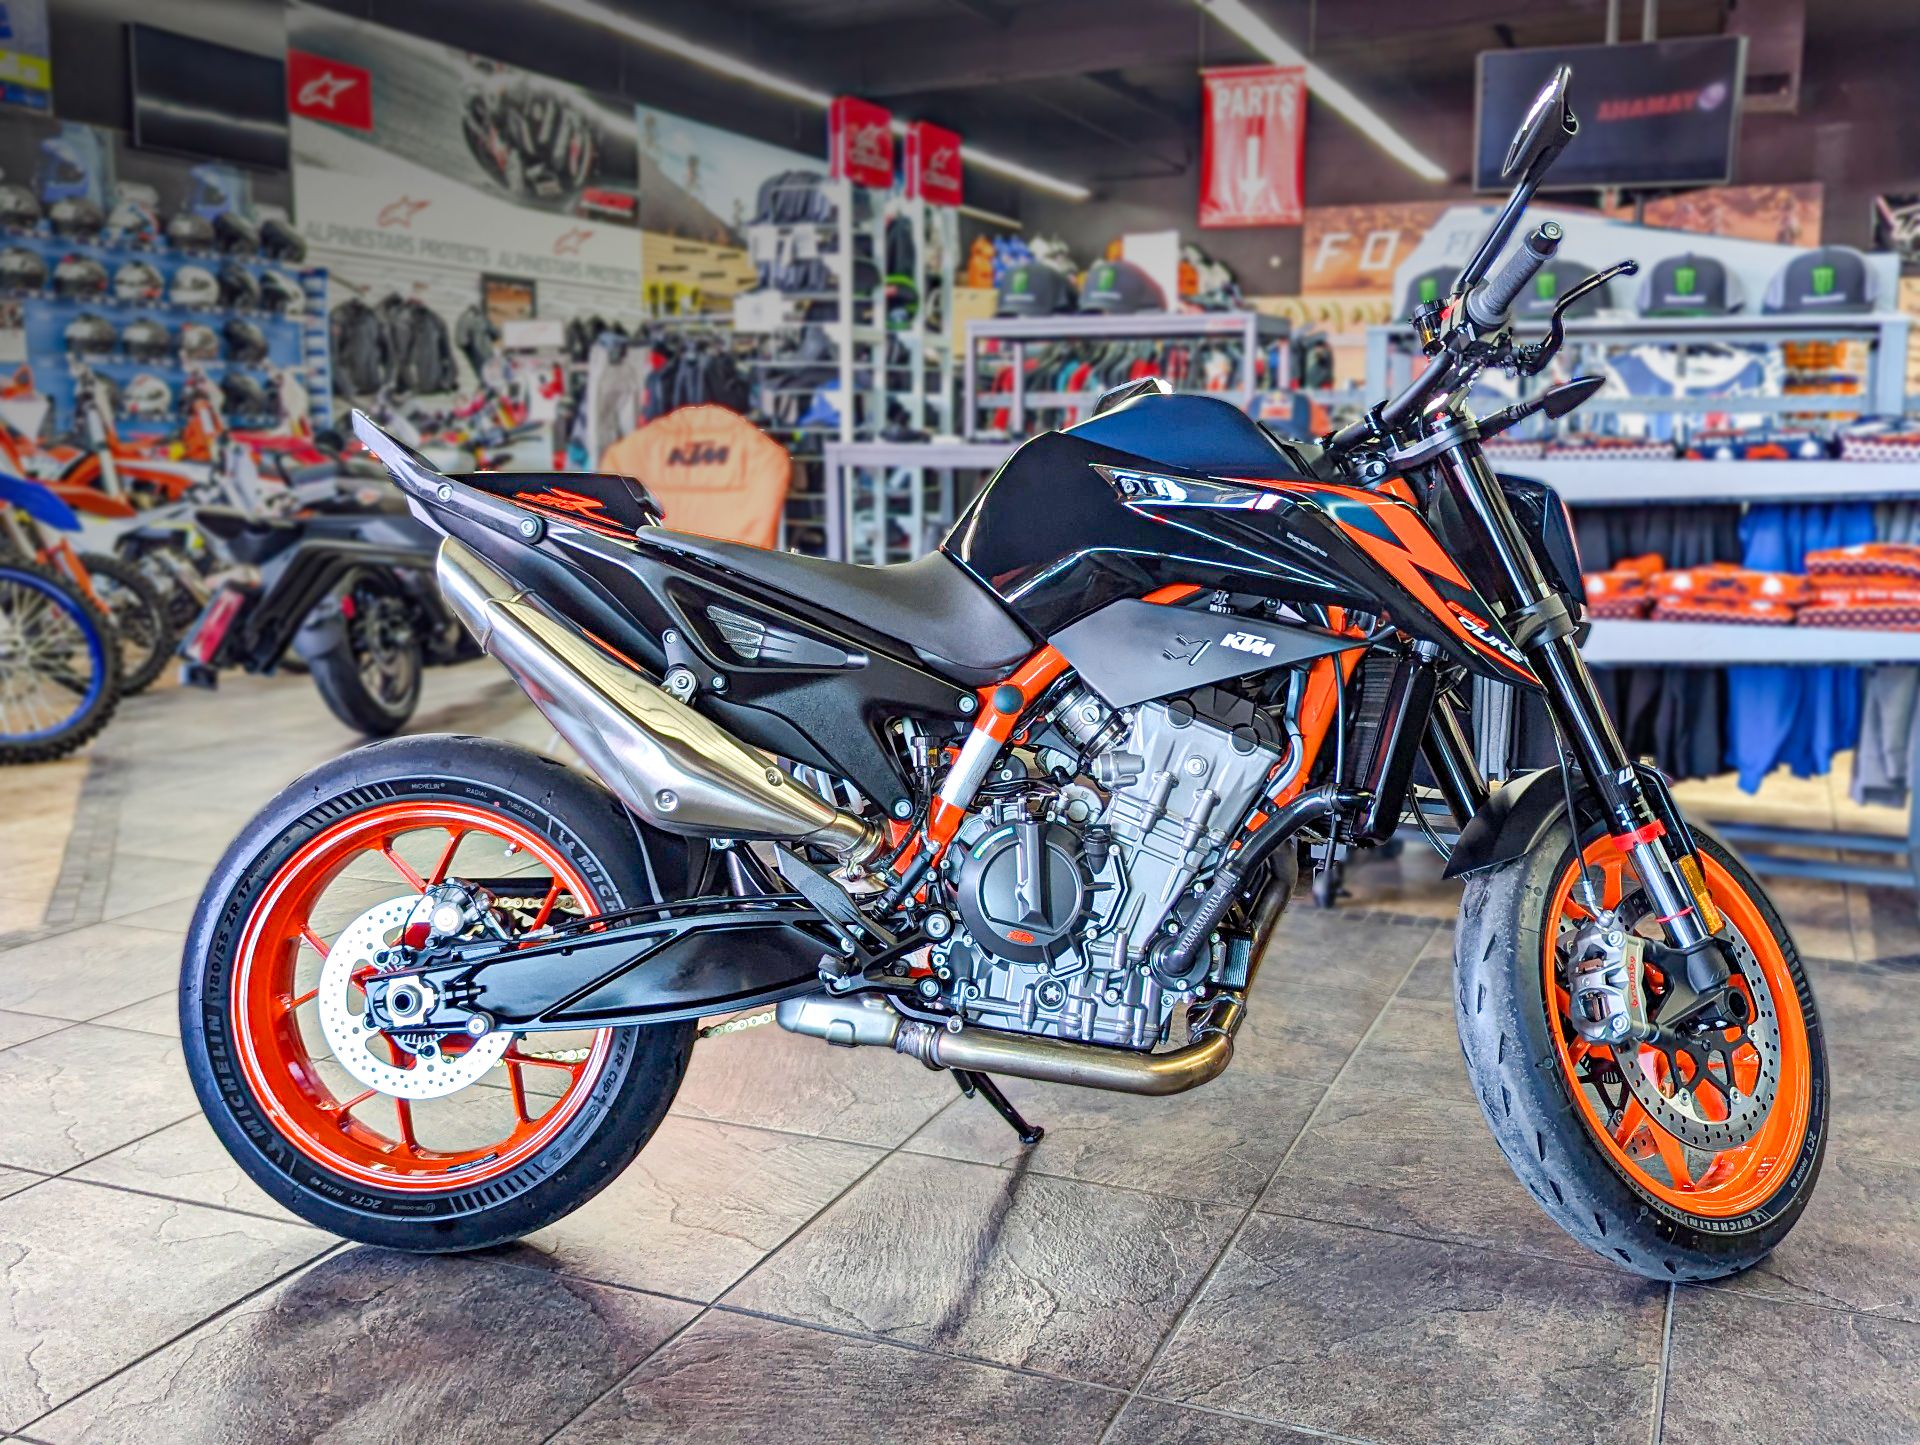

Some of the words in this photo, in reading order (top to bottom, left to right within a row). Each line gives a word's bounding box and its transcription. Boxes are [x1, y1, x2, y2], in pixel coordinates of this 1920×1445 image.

[1213, 83, 1295, 120] PARTS
[306, 221, 416, 255] ALPINESTARS
[419, 237, 490, 265] PROTECTS
[1312, 230, 1401, 273] FO
[1219, 632, 1276, 657] KTM
[1458, 616, 1524, 663] DUKE
[466, 787, 488, 798] RADIAL
[506, 800, 537, 819] TUBELESS
[209, 931, 229, 993] 180/55
[224, 901, 240, 927] ZR
[238, 879, 251, 899] 17
[207, 1014, 267, 1140] MICHELIN
[321, 1182, 344, 1197] REAR
[1688, 1217, 1753, 1232] MICHELIN
